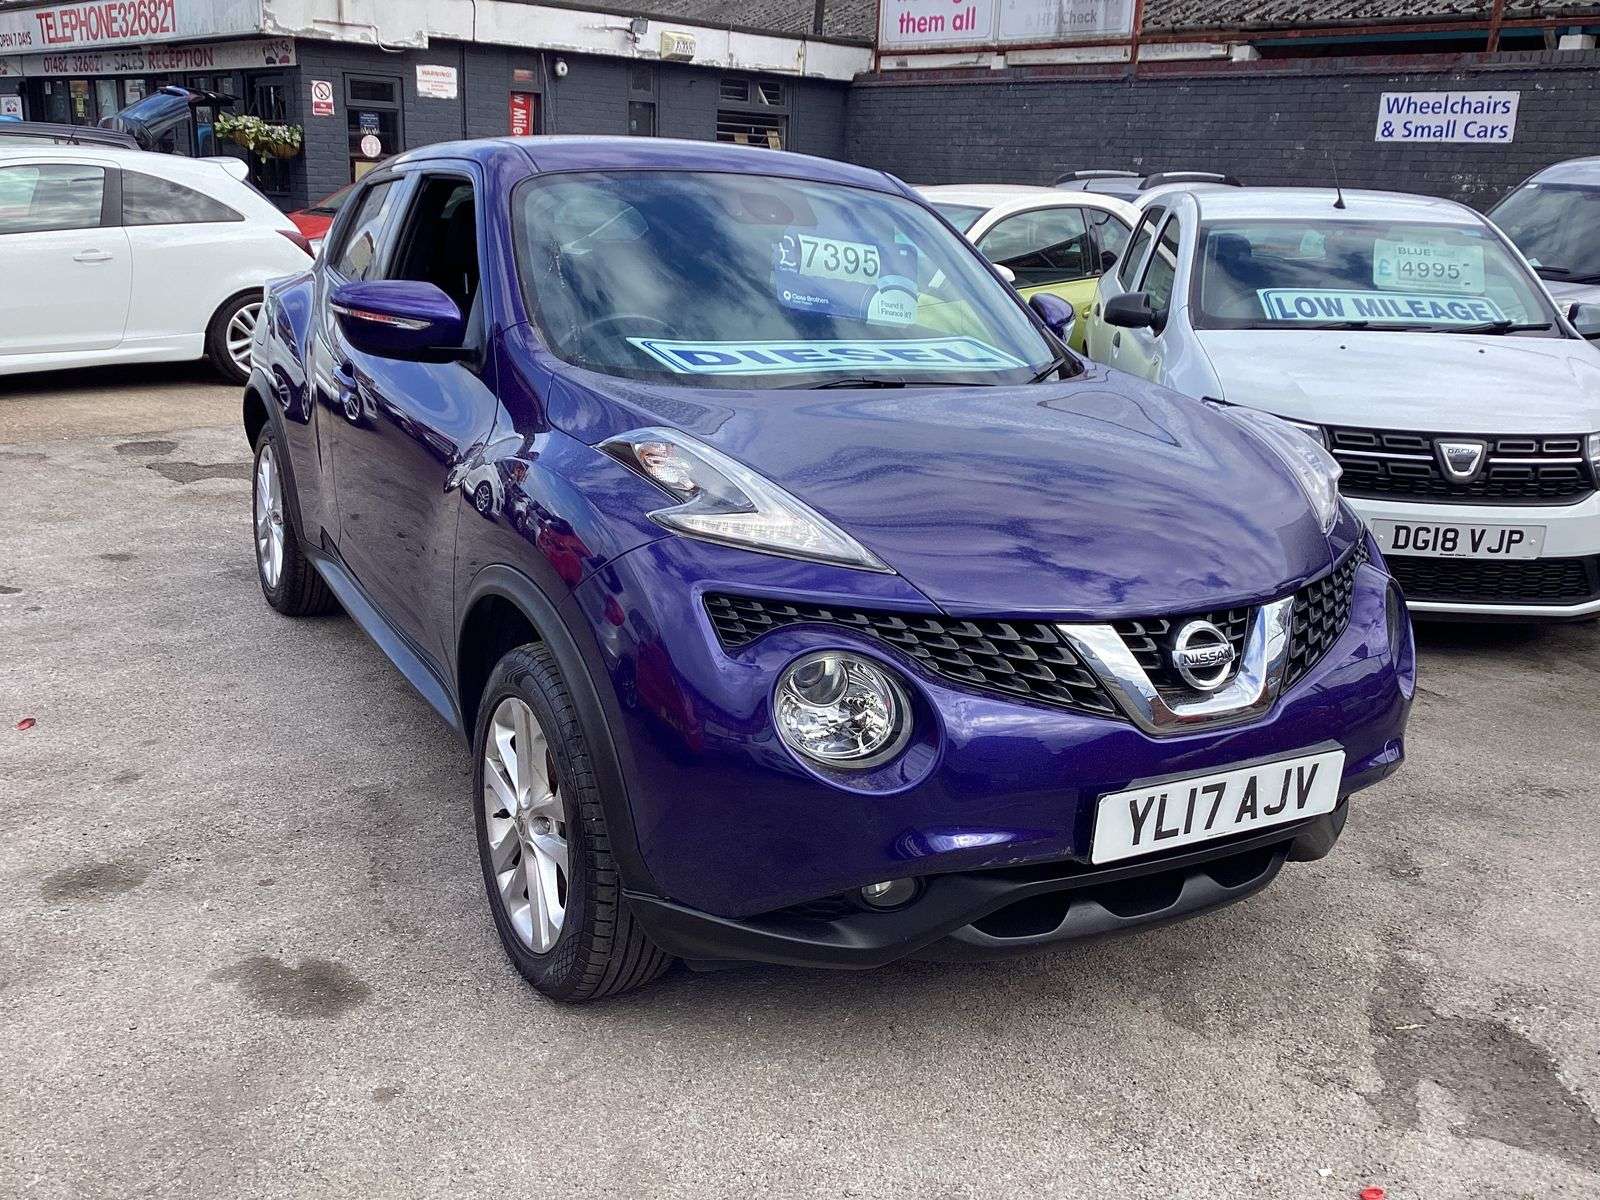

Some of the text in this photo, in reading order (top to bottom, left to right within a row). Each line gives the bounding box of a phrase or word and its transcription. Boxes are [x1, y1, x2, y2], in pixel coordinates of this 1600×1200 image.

[898, 6, 977, 34] them all
[1061, 9, 1098, 25] Check
[19, 31, 32, 45] DAYS
[43, 55, 69, 73] 01482
[72, 55, 104, 72] 326821
[114, 52, 145, 71] SALES
[148, 47, 215, 70] RECEPTION
[1386, 93, 1511, 115] Wheelchairs
[512, 107, 528, 136] Mile
[1381, 119, 1509, 139] & Small Cars
[880, 307, 904, 318] Finance
[1275, 297, 1490, 322] LOW MILEAGE
[669, 349, 996, 366] DIESEL
[1392, 525, 1525, 555] DG18 VJP
[1183, 648, 1233, 665] NISSAN
[1128, 763, 1320, 846] YL17 AJV
